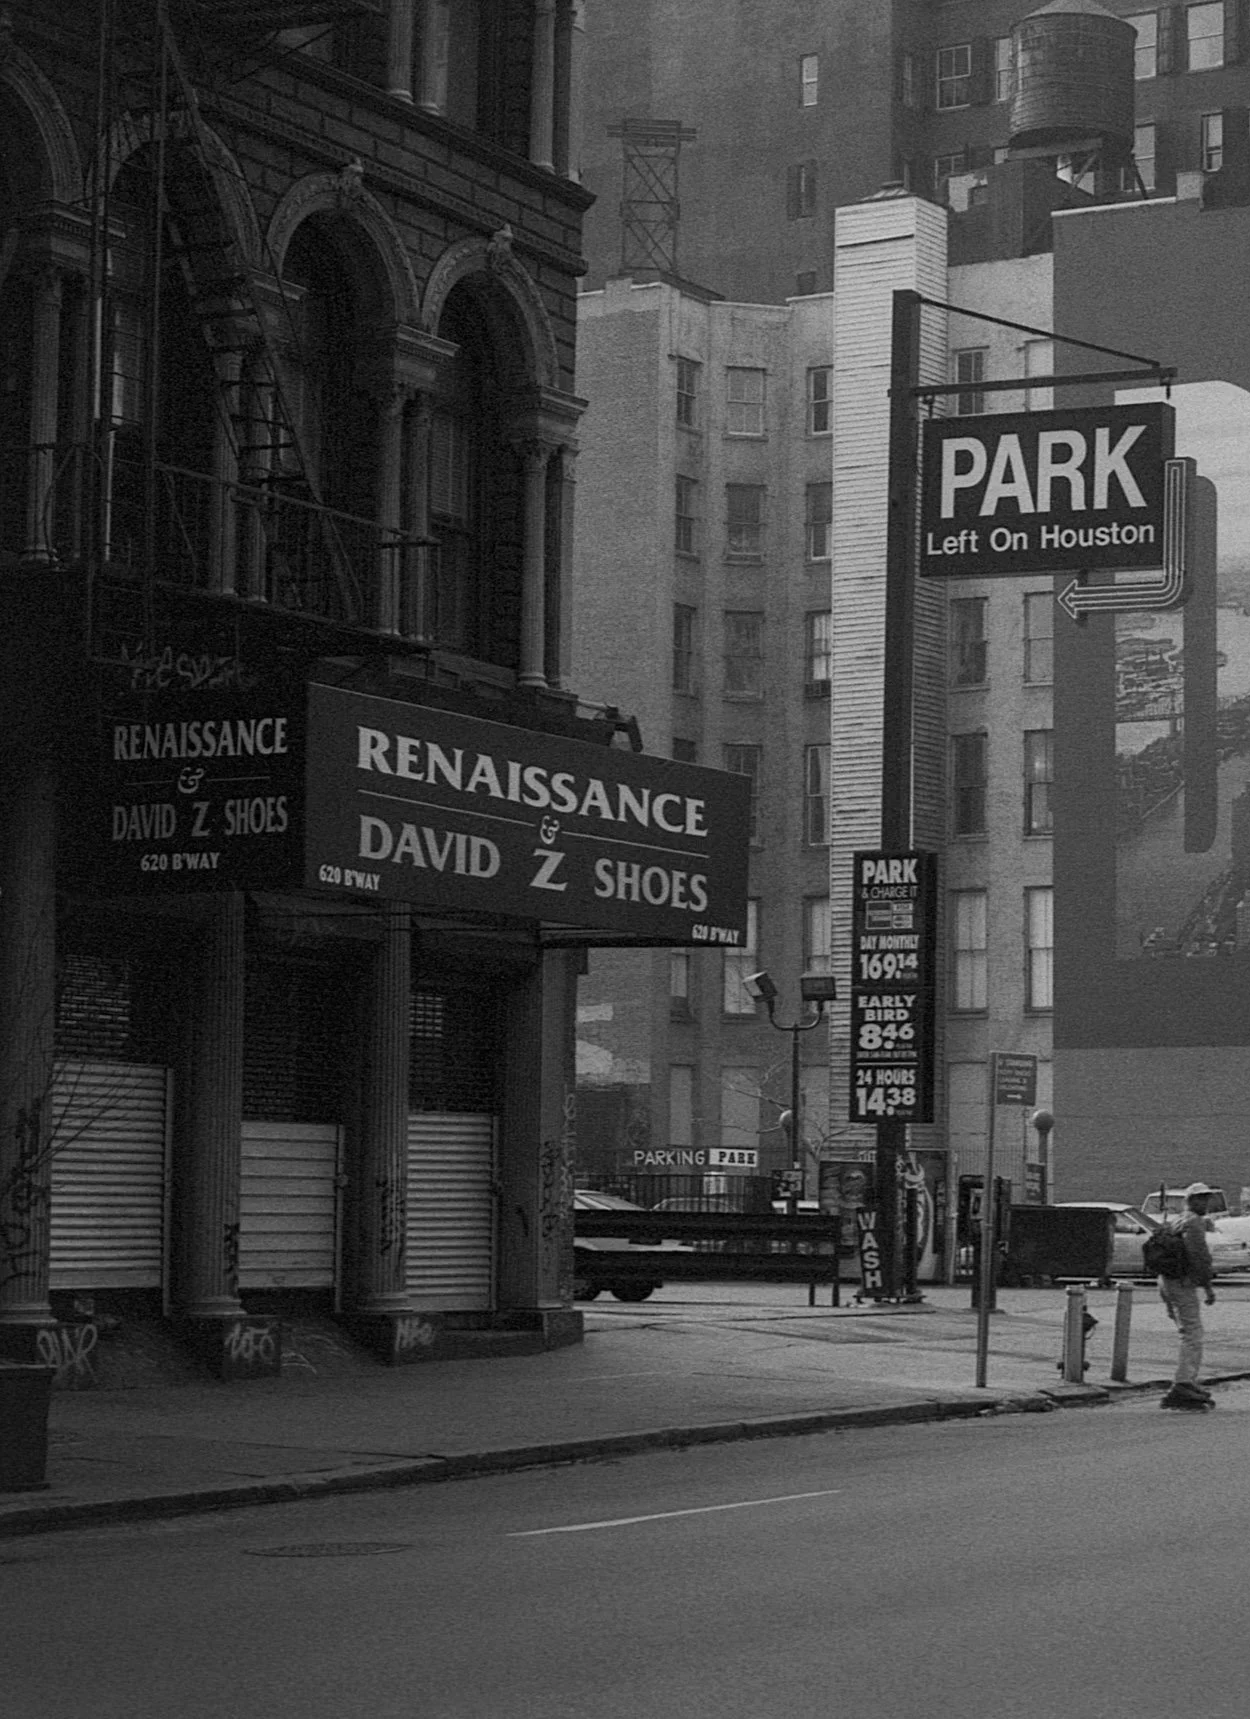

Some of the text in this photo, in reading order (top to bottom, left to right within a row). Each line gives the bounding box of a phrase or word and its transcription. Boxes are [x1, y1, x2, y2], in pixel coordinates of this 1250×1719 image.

[940, 425, 1148, 518] PARK
[927, 522, 1155, 556] Left On Houston
[114, 718, 288, 760] RENAISSANCE
[178, 767, 204, 794] &
[357, 726, 710, 838] RENAISSANCE
[112, 796, 288, 841] DAVID Z SHOES
[540, 816, 560, 844] &
[140, 852, 220, 871] 620 B'WAY
[358, 814, 709, 913] DAVID Z SHOES
[862, 858, 919, 885] PARK
[319, 864, 380, 891] 620 B'WAY
[871, 886, 908, 898] CHARGE
[860, 935, 920, 950] DAY MONTHLY
[858, 995, 917, 1008] EARLY
[864, 1009, 909, 1021] BIRD
[856, 1069, 916, 1085] 24 HOURS
[634, 1150, 705, 1166] PARKING
[719, 1151, 755, 1165] PARK
[857, 1211, 882, 1289] WASH
